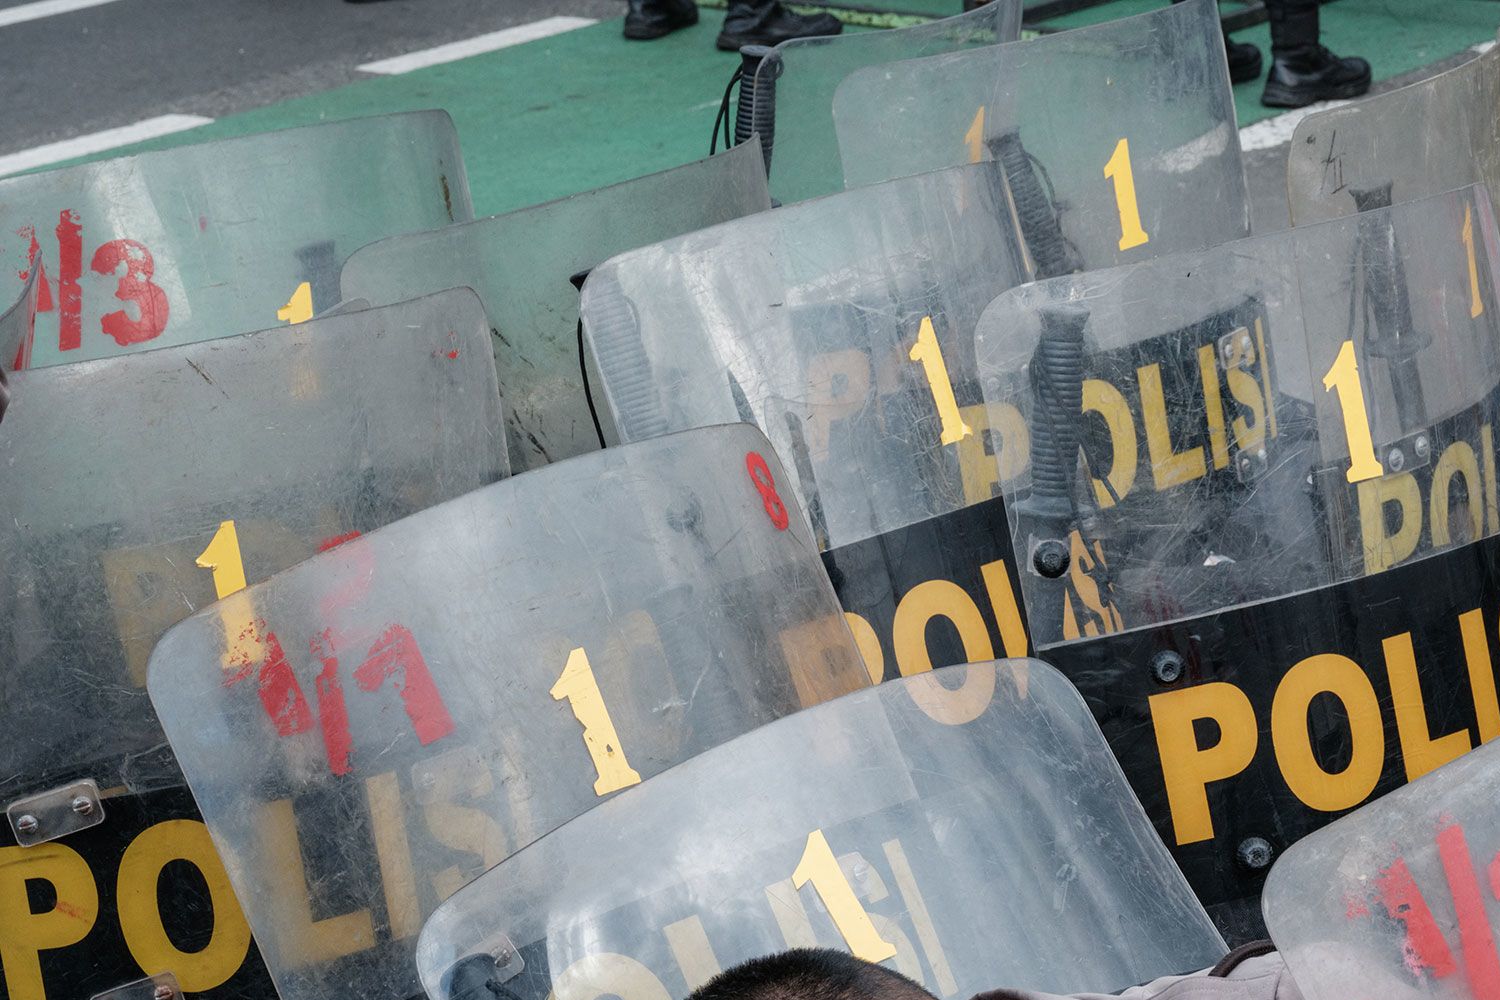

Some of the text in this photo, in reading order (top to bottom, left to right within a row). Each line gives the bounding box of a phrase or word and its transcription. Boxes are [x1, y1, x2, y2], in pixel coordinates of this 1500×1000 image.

[1103, 138, 1149, 251] 1
[909, 316, 973, 446] 1
[1322, 340, 1384, 483] 1
[746, 452, 790, 530] 8
[196, 520, 266, 668] 1
[550, 647, 641, 796] 1
[791, 829, 897, 963] 1
